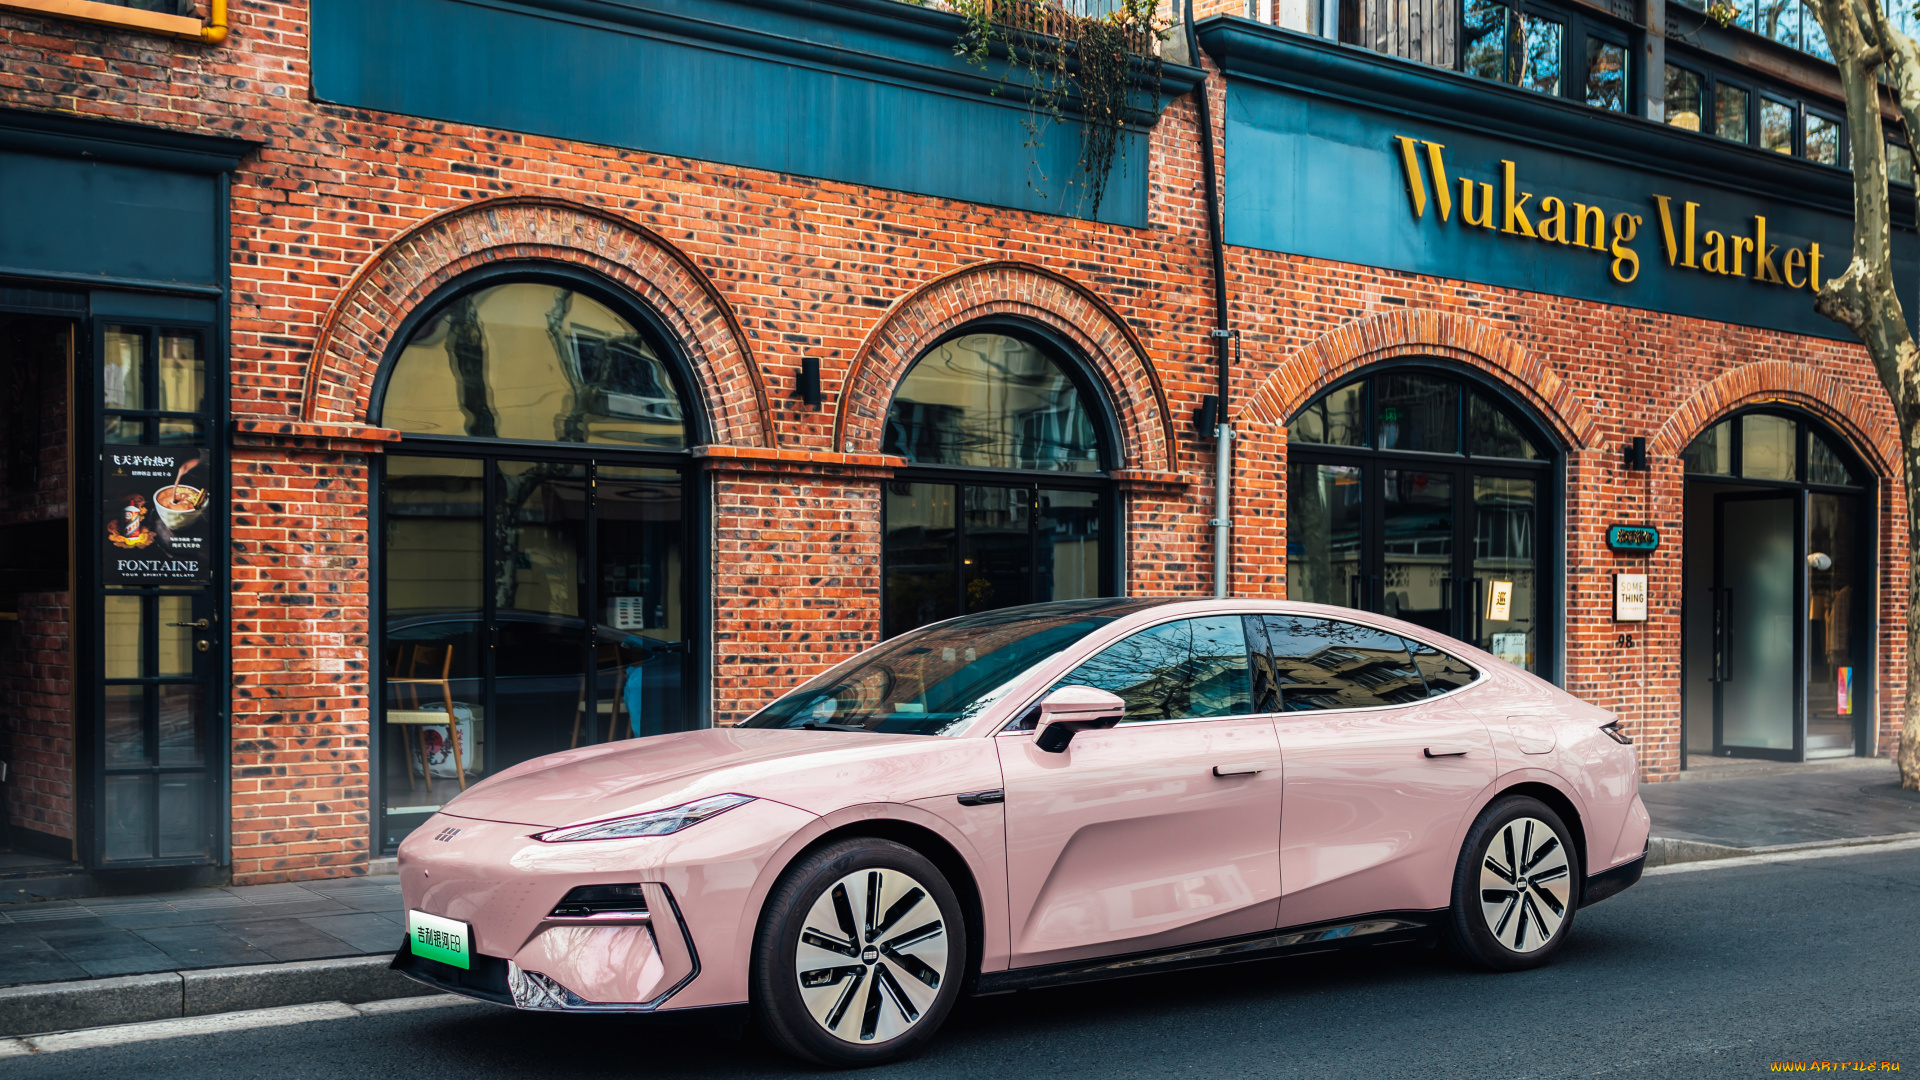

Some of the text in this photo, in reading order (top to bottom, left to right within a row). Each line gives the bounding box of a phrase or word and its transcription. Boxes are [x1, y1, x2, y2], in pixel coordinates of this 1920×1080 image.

[1393, 135, 1825, 293] Wukang Market
[110, 455, 174, 467] 飞天茅台热巧
[117, 560, 199, 571] FONTAINE
[1620, 582, 1644, 591] SOME
[1621, 593, 1644, 603] THING
[1617, 634, 1633, 648] 98
